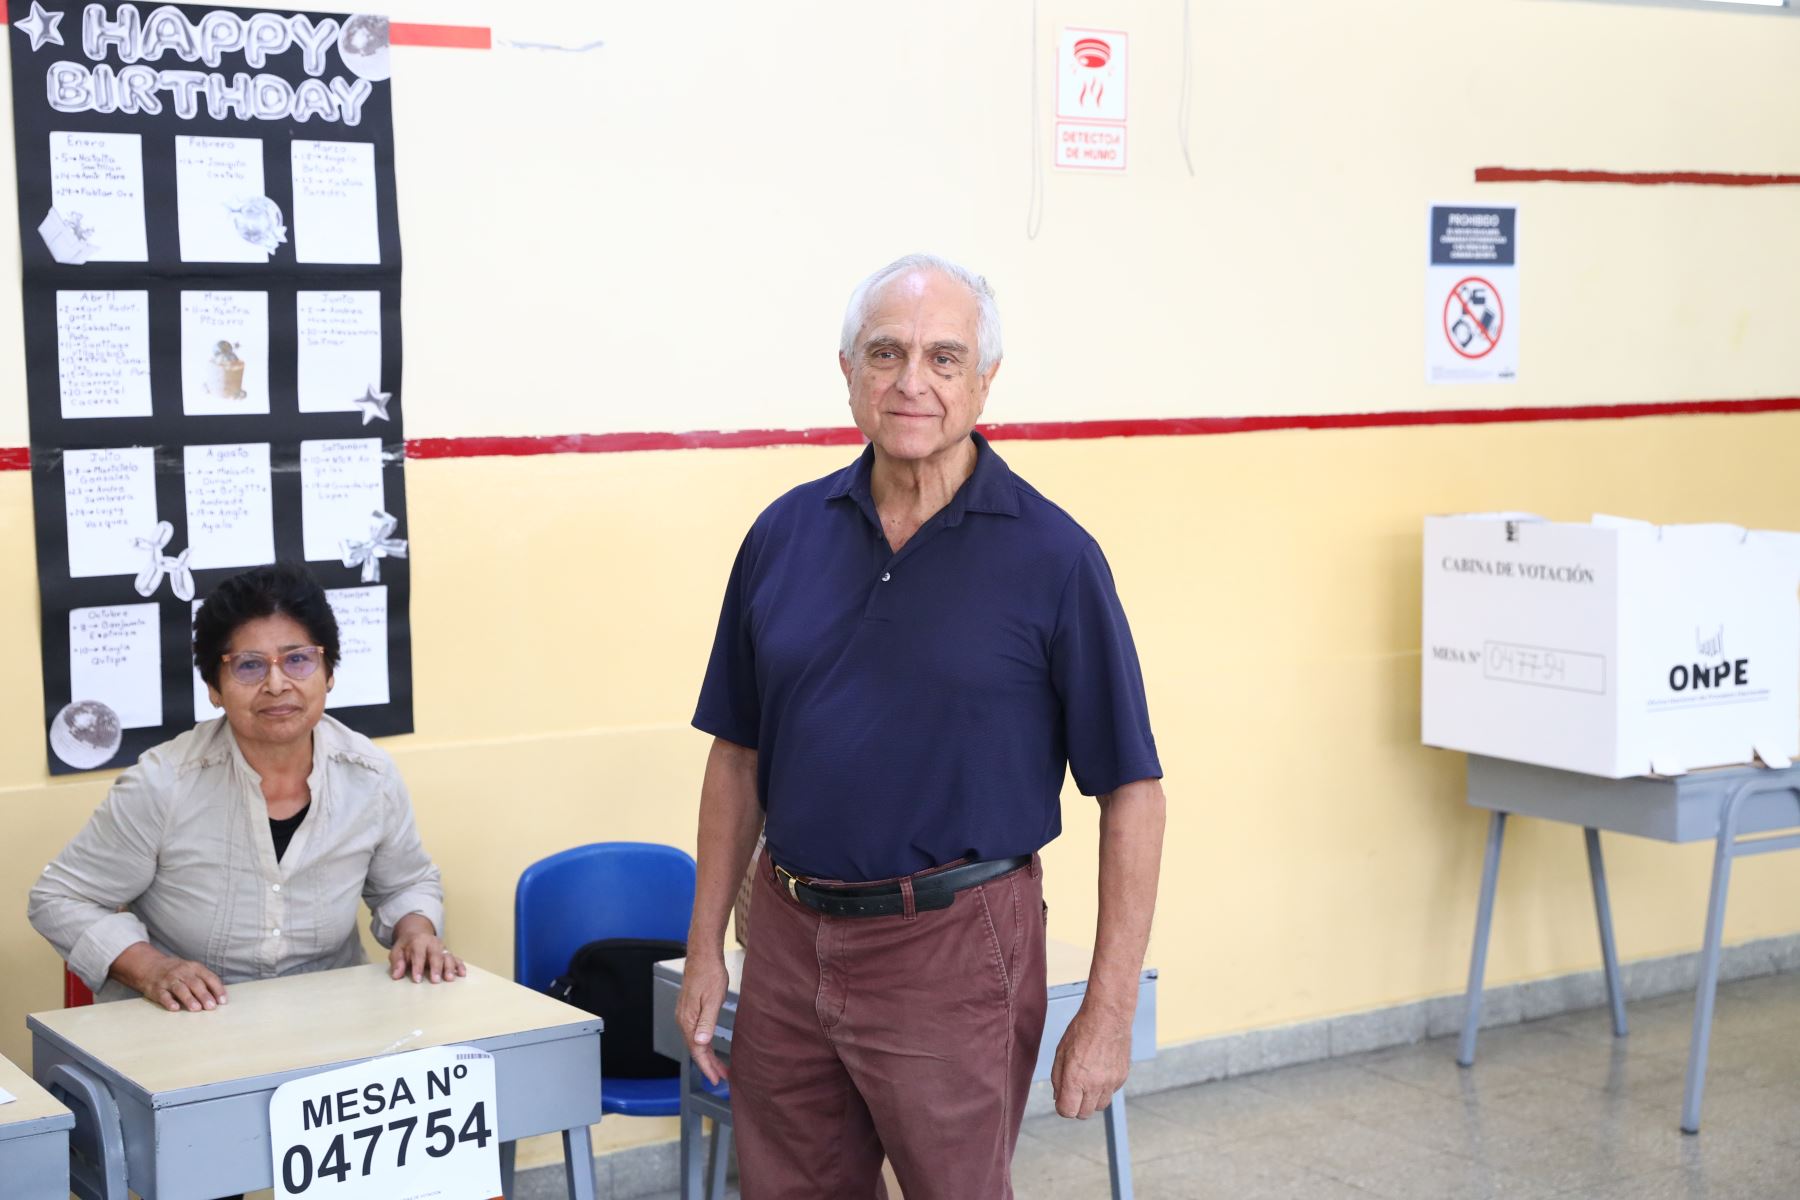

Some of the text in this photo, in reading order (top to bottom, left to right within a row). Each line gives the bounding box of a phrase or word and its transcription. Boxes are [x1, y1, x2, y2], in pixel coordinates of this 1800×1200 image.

[82, 3, 340, 76] HAPPY
[46, 60, 373, 126] BIRTHDAY
[67, 134, 105, 147] Enero
[189, 137, 235, 149] Febrero
[313, 141, 346, 152] Marzo
[1083, 148, 1117, 160] HUMO
[1442, 556, 1595, 584] CABINA DE VOTACIÓN
[1432, 645, 1466, 663] MESA
[1669, 659, 1749, 691] ONPE
[303, 1077, 415, 1131] MESA
[282, 1101, 492, 1195] 047754
